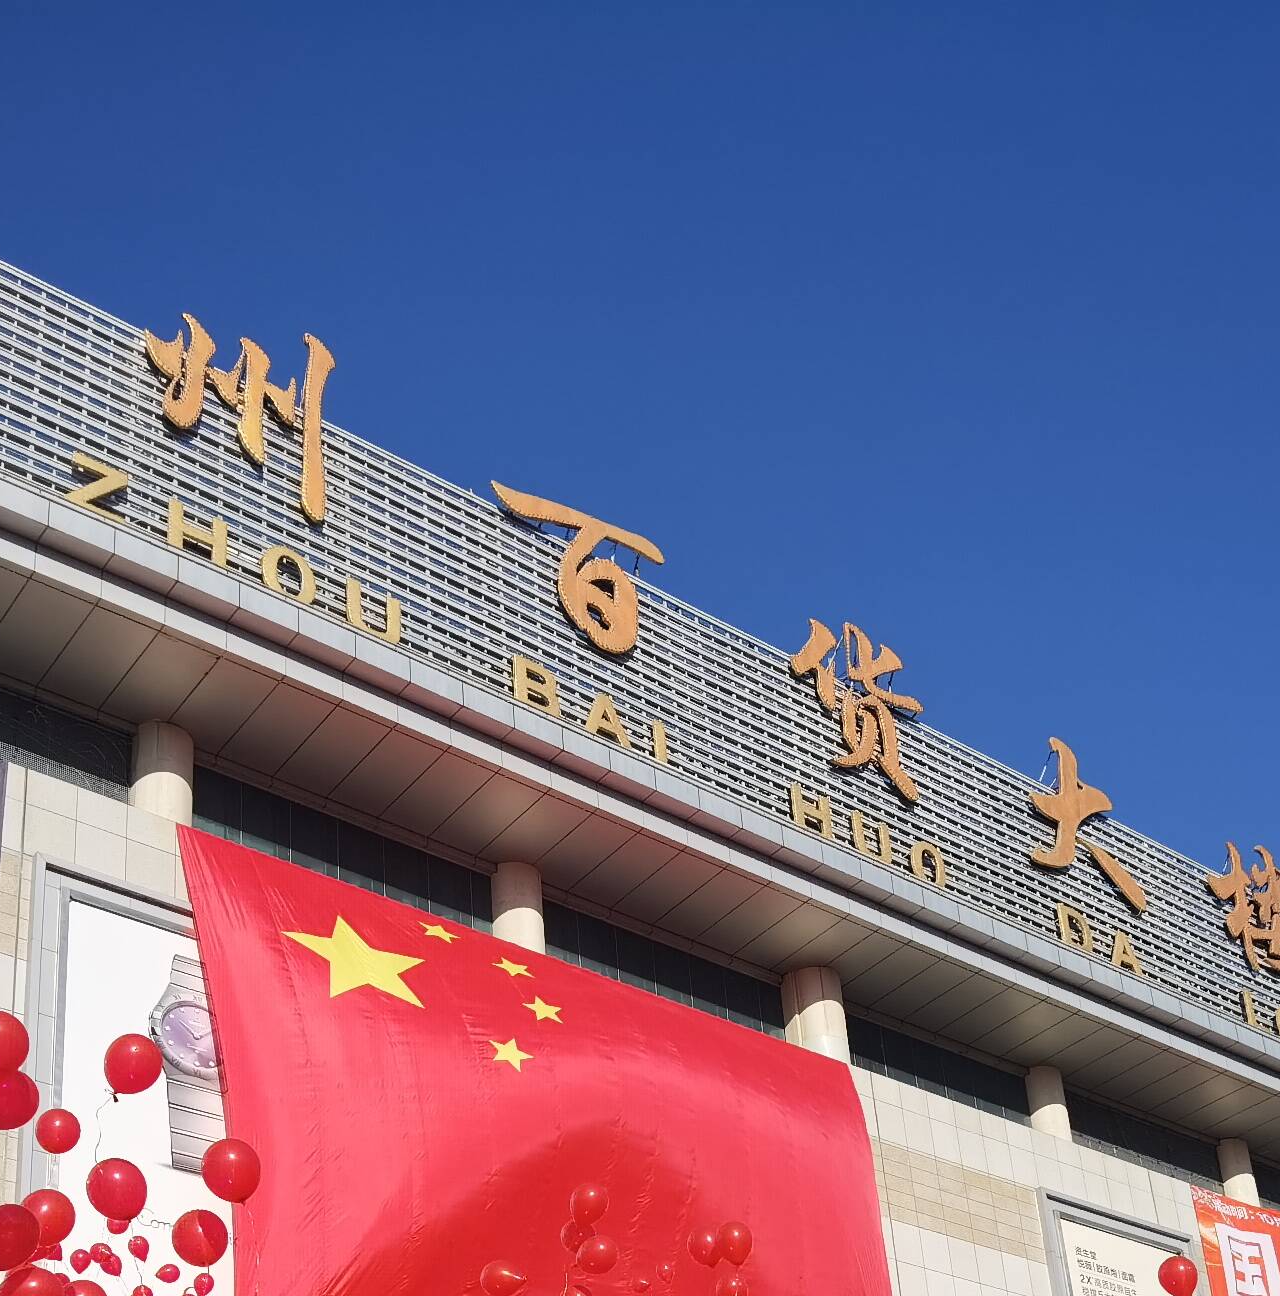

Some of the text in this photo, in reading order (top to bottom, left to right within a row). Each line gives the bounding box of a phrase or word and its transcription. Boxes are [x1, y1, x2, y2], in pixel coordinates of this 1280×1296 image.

[67, 452, 402, 646] ZHOU
[512, 654, 668, 765] BAI
[790, 783, 947, 889] HUO
[1057, 902, 1143, 977] DA
